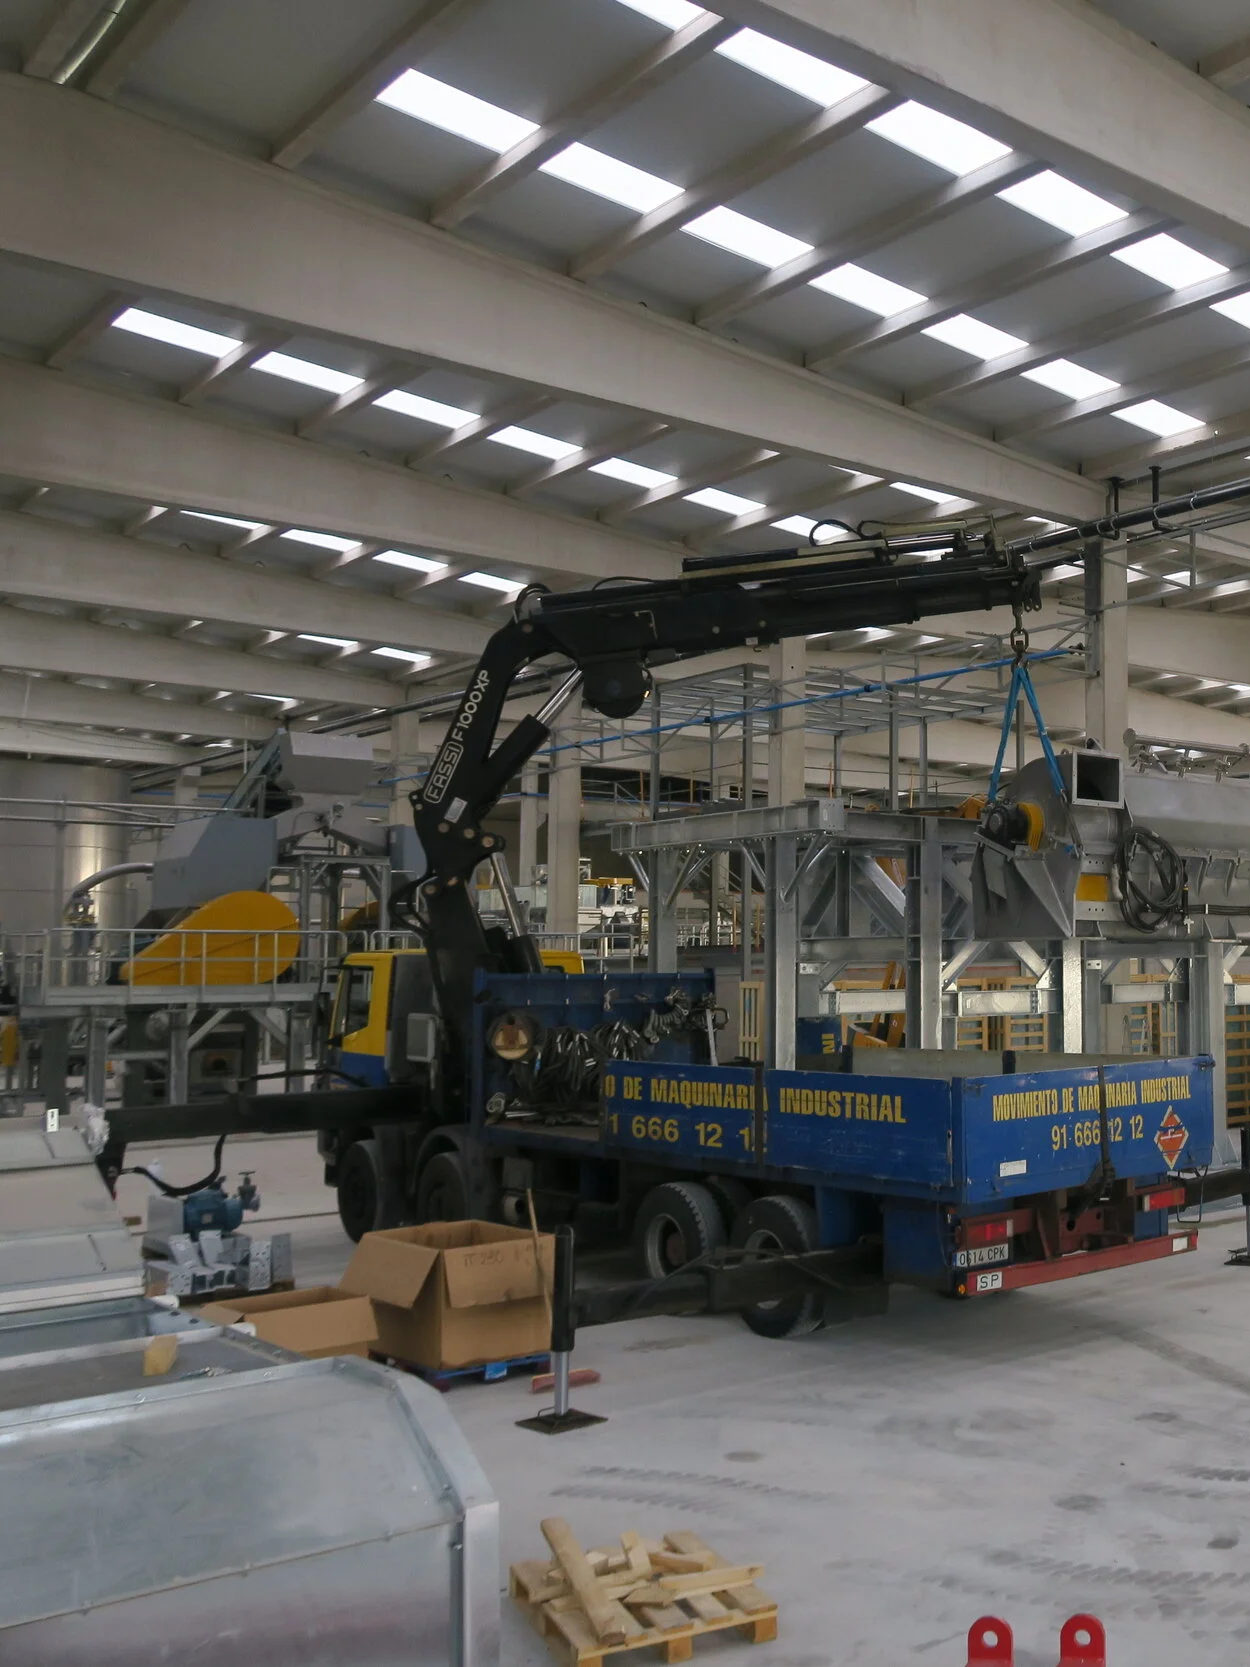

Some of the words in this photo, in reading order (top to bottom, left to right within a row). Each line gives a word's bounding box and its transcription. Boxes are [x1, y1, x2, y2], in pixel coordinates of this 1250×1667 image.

[426, 744, 462, 800] FASSI
[451, 669, 490, 742] F1000XP
[623, 1076, 643, 1101] DE
[779, 1087, 907, 1123] INDUSTRIAL
[991, 1088, 1058, 1122] MOVIMIENTO
[1062, 1087, 1074, 1113] DE
[1077, 1080, 1137, 1114] MAQINARIA
[1140, 1075, 1192, 1104] INDUSTRIAL
[631, 1115, 680, 1142] 666
[694, 1122, 723, 1148] 12
[1051, 1124, 1067, 1150] 91
[1074, 1120, 1100, 1147] 666
[1107, 1117, 1123, 1142] 12
[1130, 1115, 1144, 1140] 12
[987, 1245, 1005, 1261] CPK
